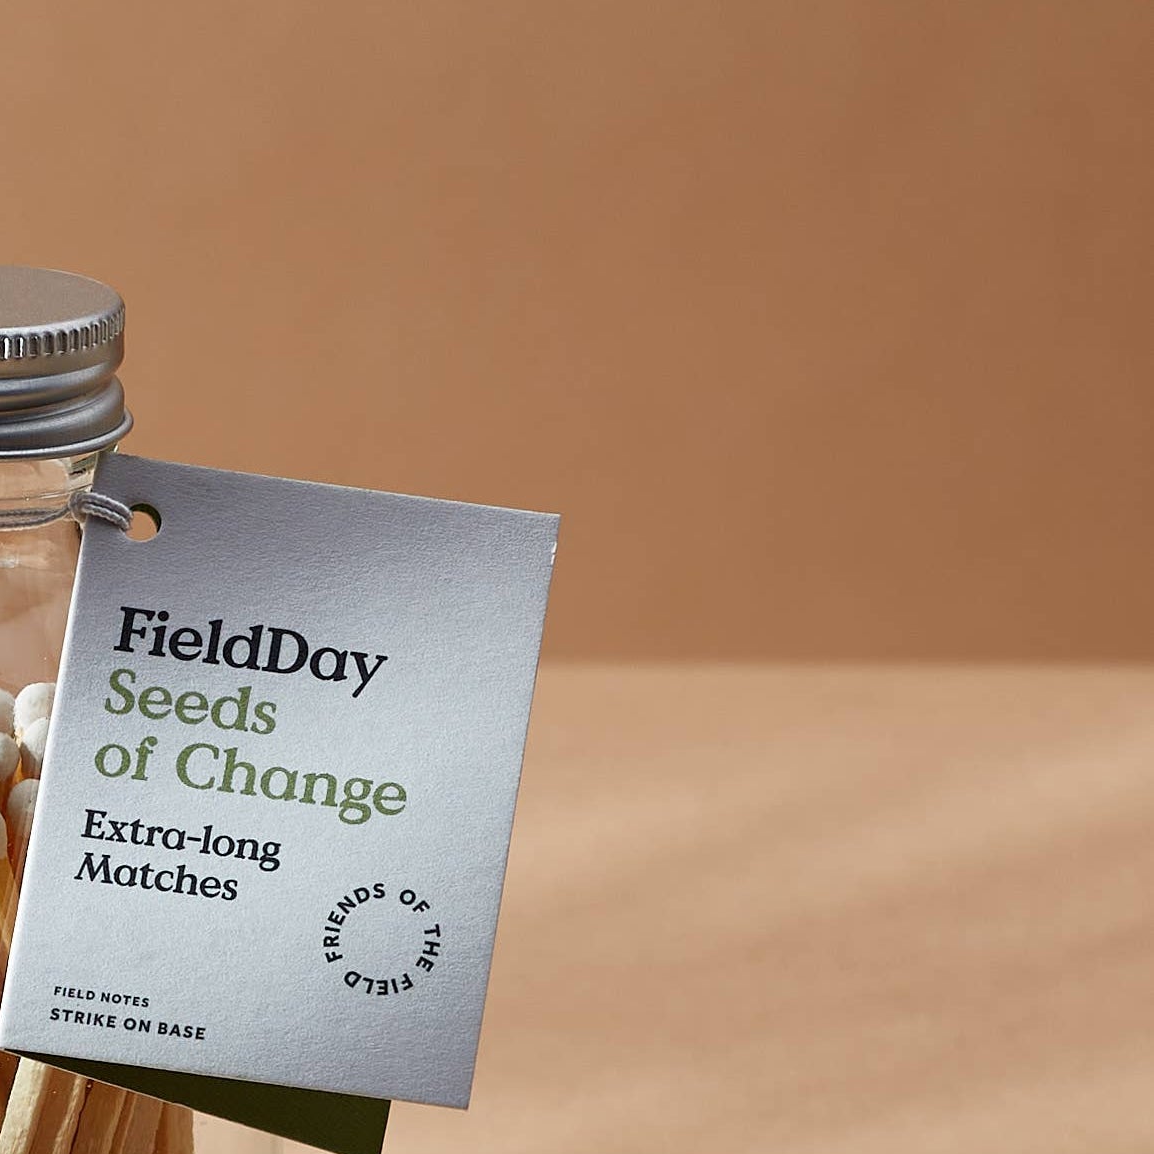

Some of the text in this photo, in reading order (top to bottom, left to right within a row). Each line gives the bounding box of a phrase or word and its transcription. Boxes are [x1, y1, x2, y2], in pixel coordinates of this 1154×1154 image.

[113, 605, 388, 699] FieldDay
[104, 668, 277, 735] Seeds
[94, 735, 407, 826] of Change
[80, 808, 282, 873] Extra-long
[73, 851, 239, 902] Matches
[322, 882, 442, 996] FRIENDS OF THE FIELD
[49, 1007, 207, 1041] STRIKE ON BASE
[53, 985, 150, 1008] FIELD NOTES
